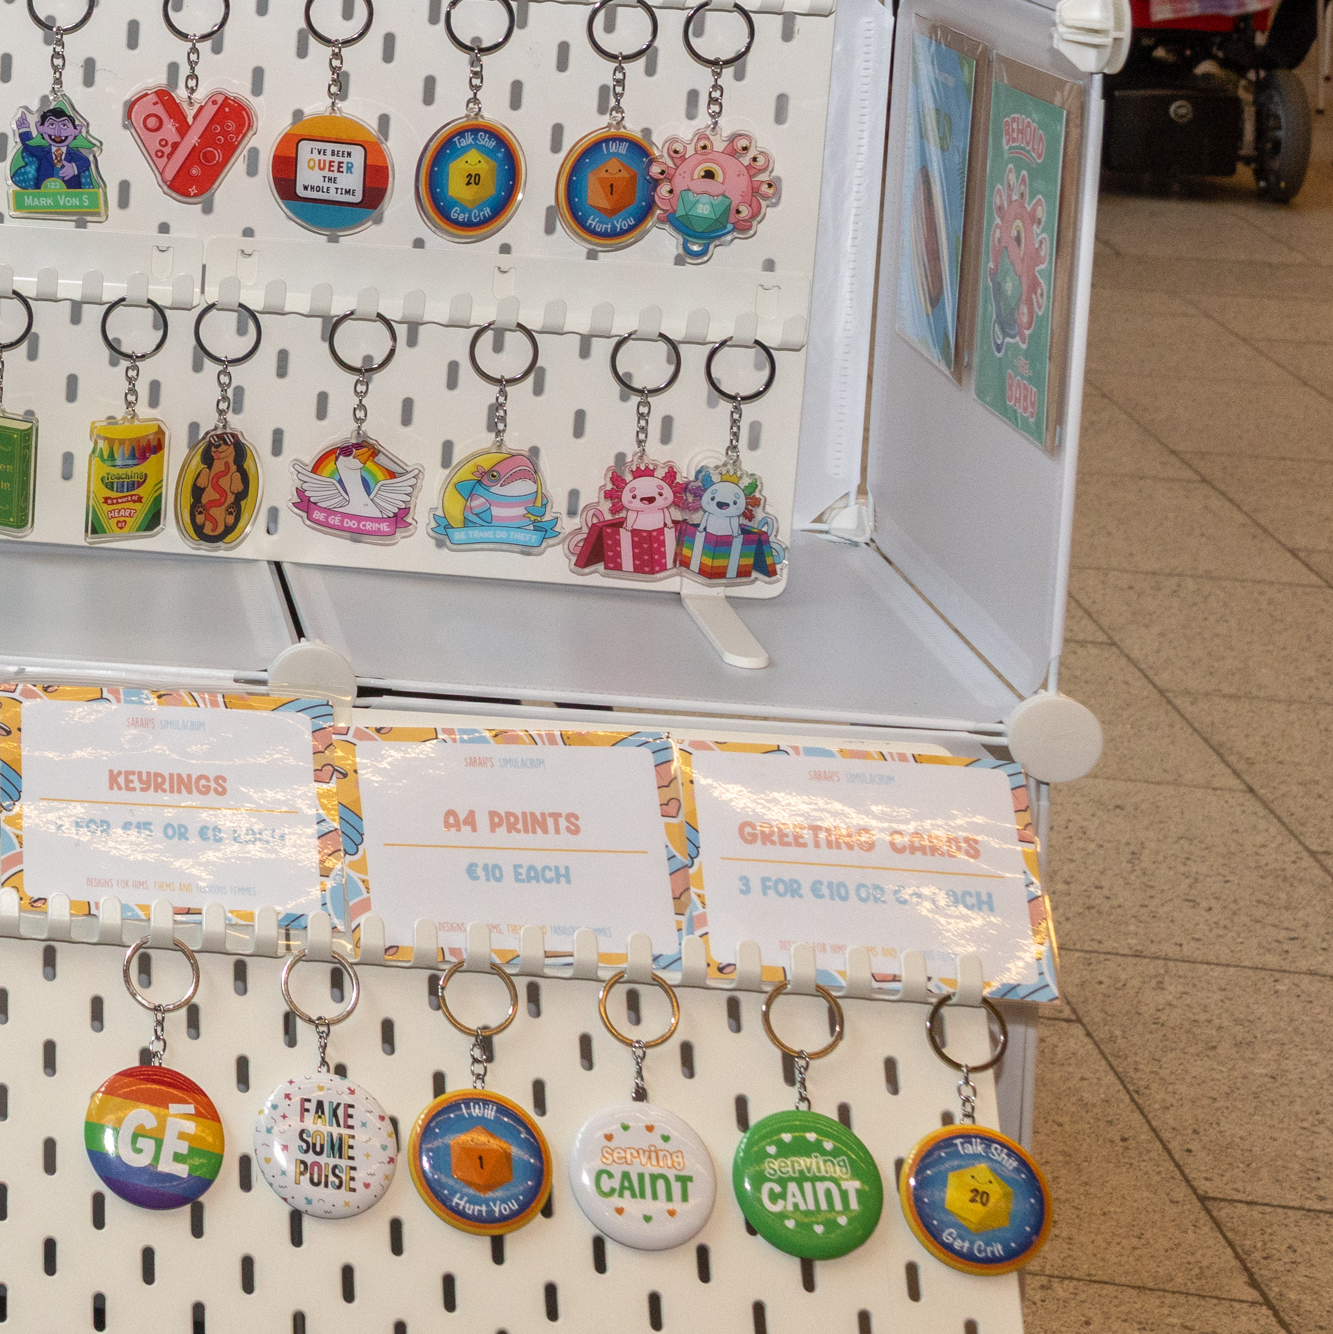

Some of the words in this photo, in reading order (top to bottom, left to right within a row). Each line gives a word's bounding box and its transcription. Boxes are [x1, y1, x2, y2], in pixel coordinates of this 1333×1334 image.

[107, 768, 229, 797] KEYRINGS
[443, 808, 478, 834] A4
[489, 808, 582, 837] PRINTS
[299, 1098, 354, 1129] FAKE
[298, 1129, 355, 1160] SOME
[294, 1158, 357, 1192] POISE
